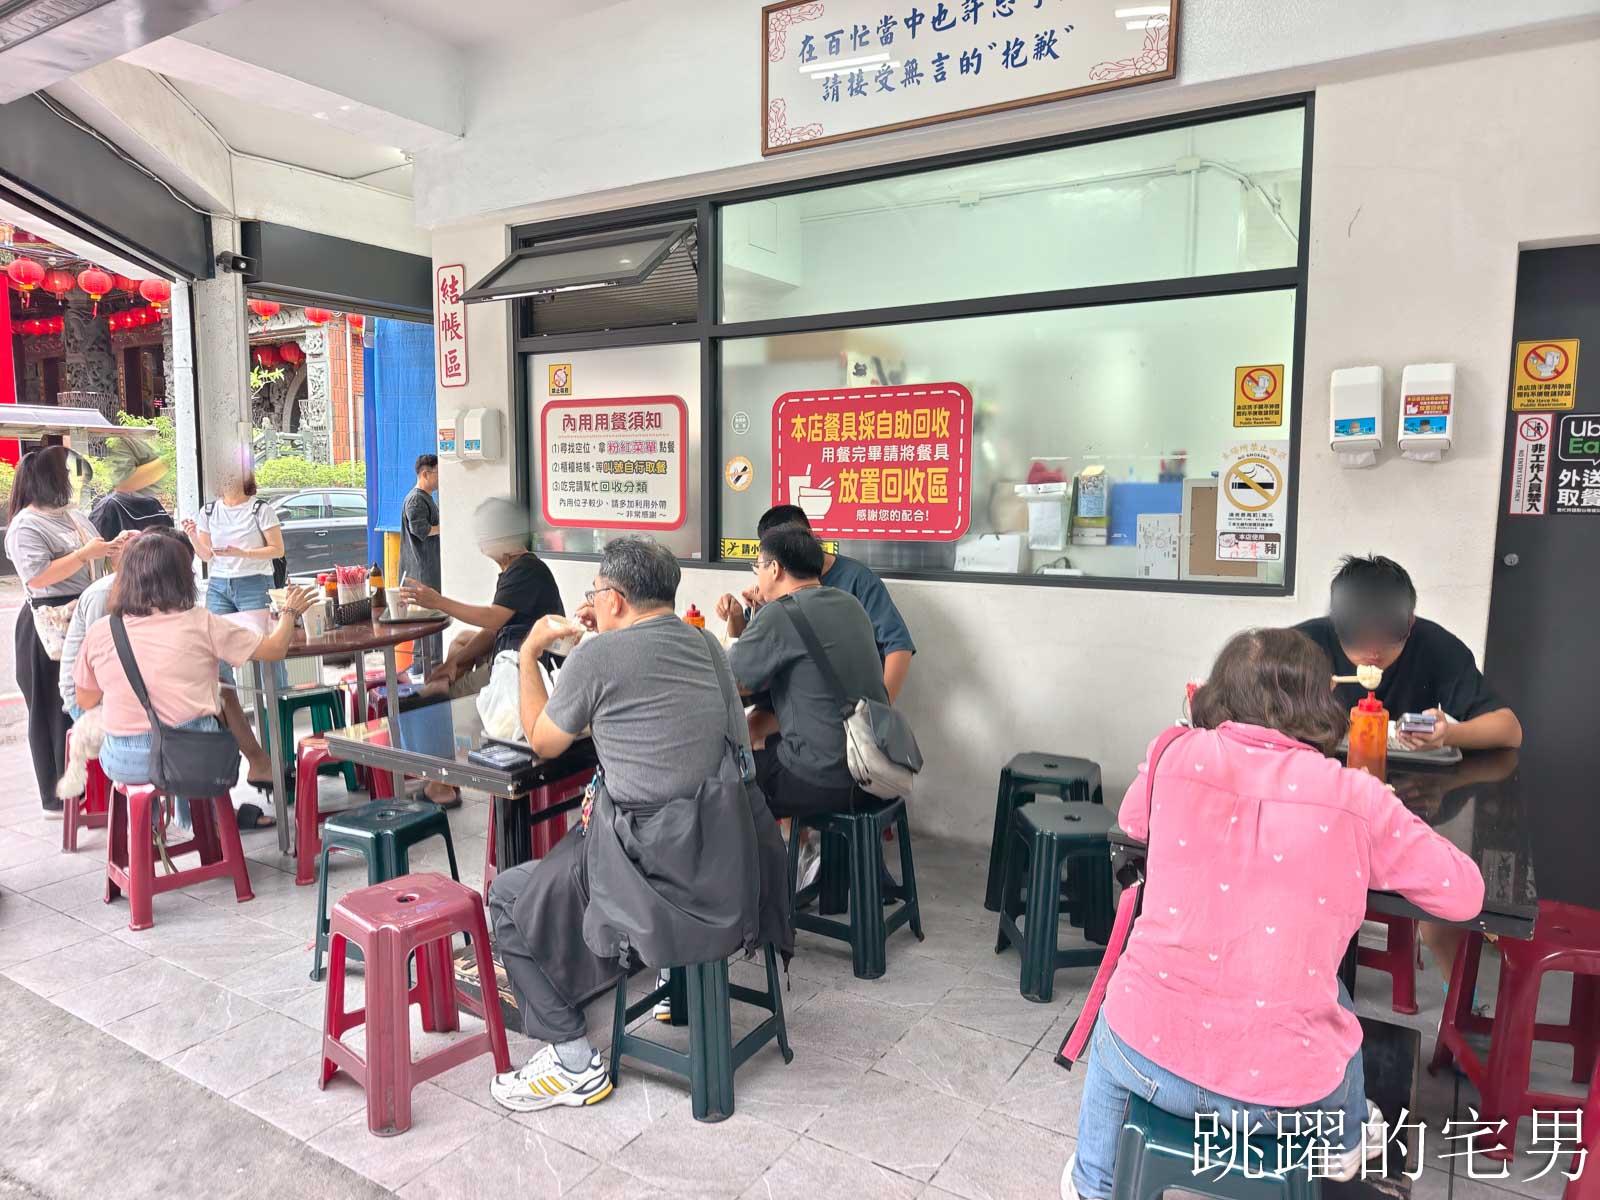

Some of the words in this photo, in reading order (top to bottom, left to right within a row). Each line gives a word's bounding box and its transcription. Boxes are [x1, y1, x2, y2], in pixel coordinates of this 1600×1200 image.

[440, 275, 463, 378] 結帳區
[562, 411, 662, 432] 內用用餐須知
[790, 406, 951, 443] 本店餐具採自助回收
[821, 443, 950, 463] 用餐完畢請將餐具
[838, 467, 950, 505] 放置回收區
[1526, 443, 1546, 512] 非工作人員禁入
